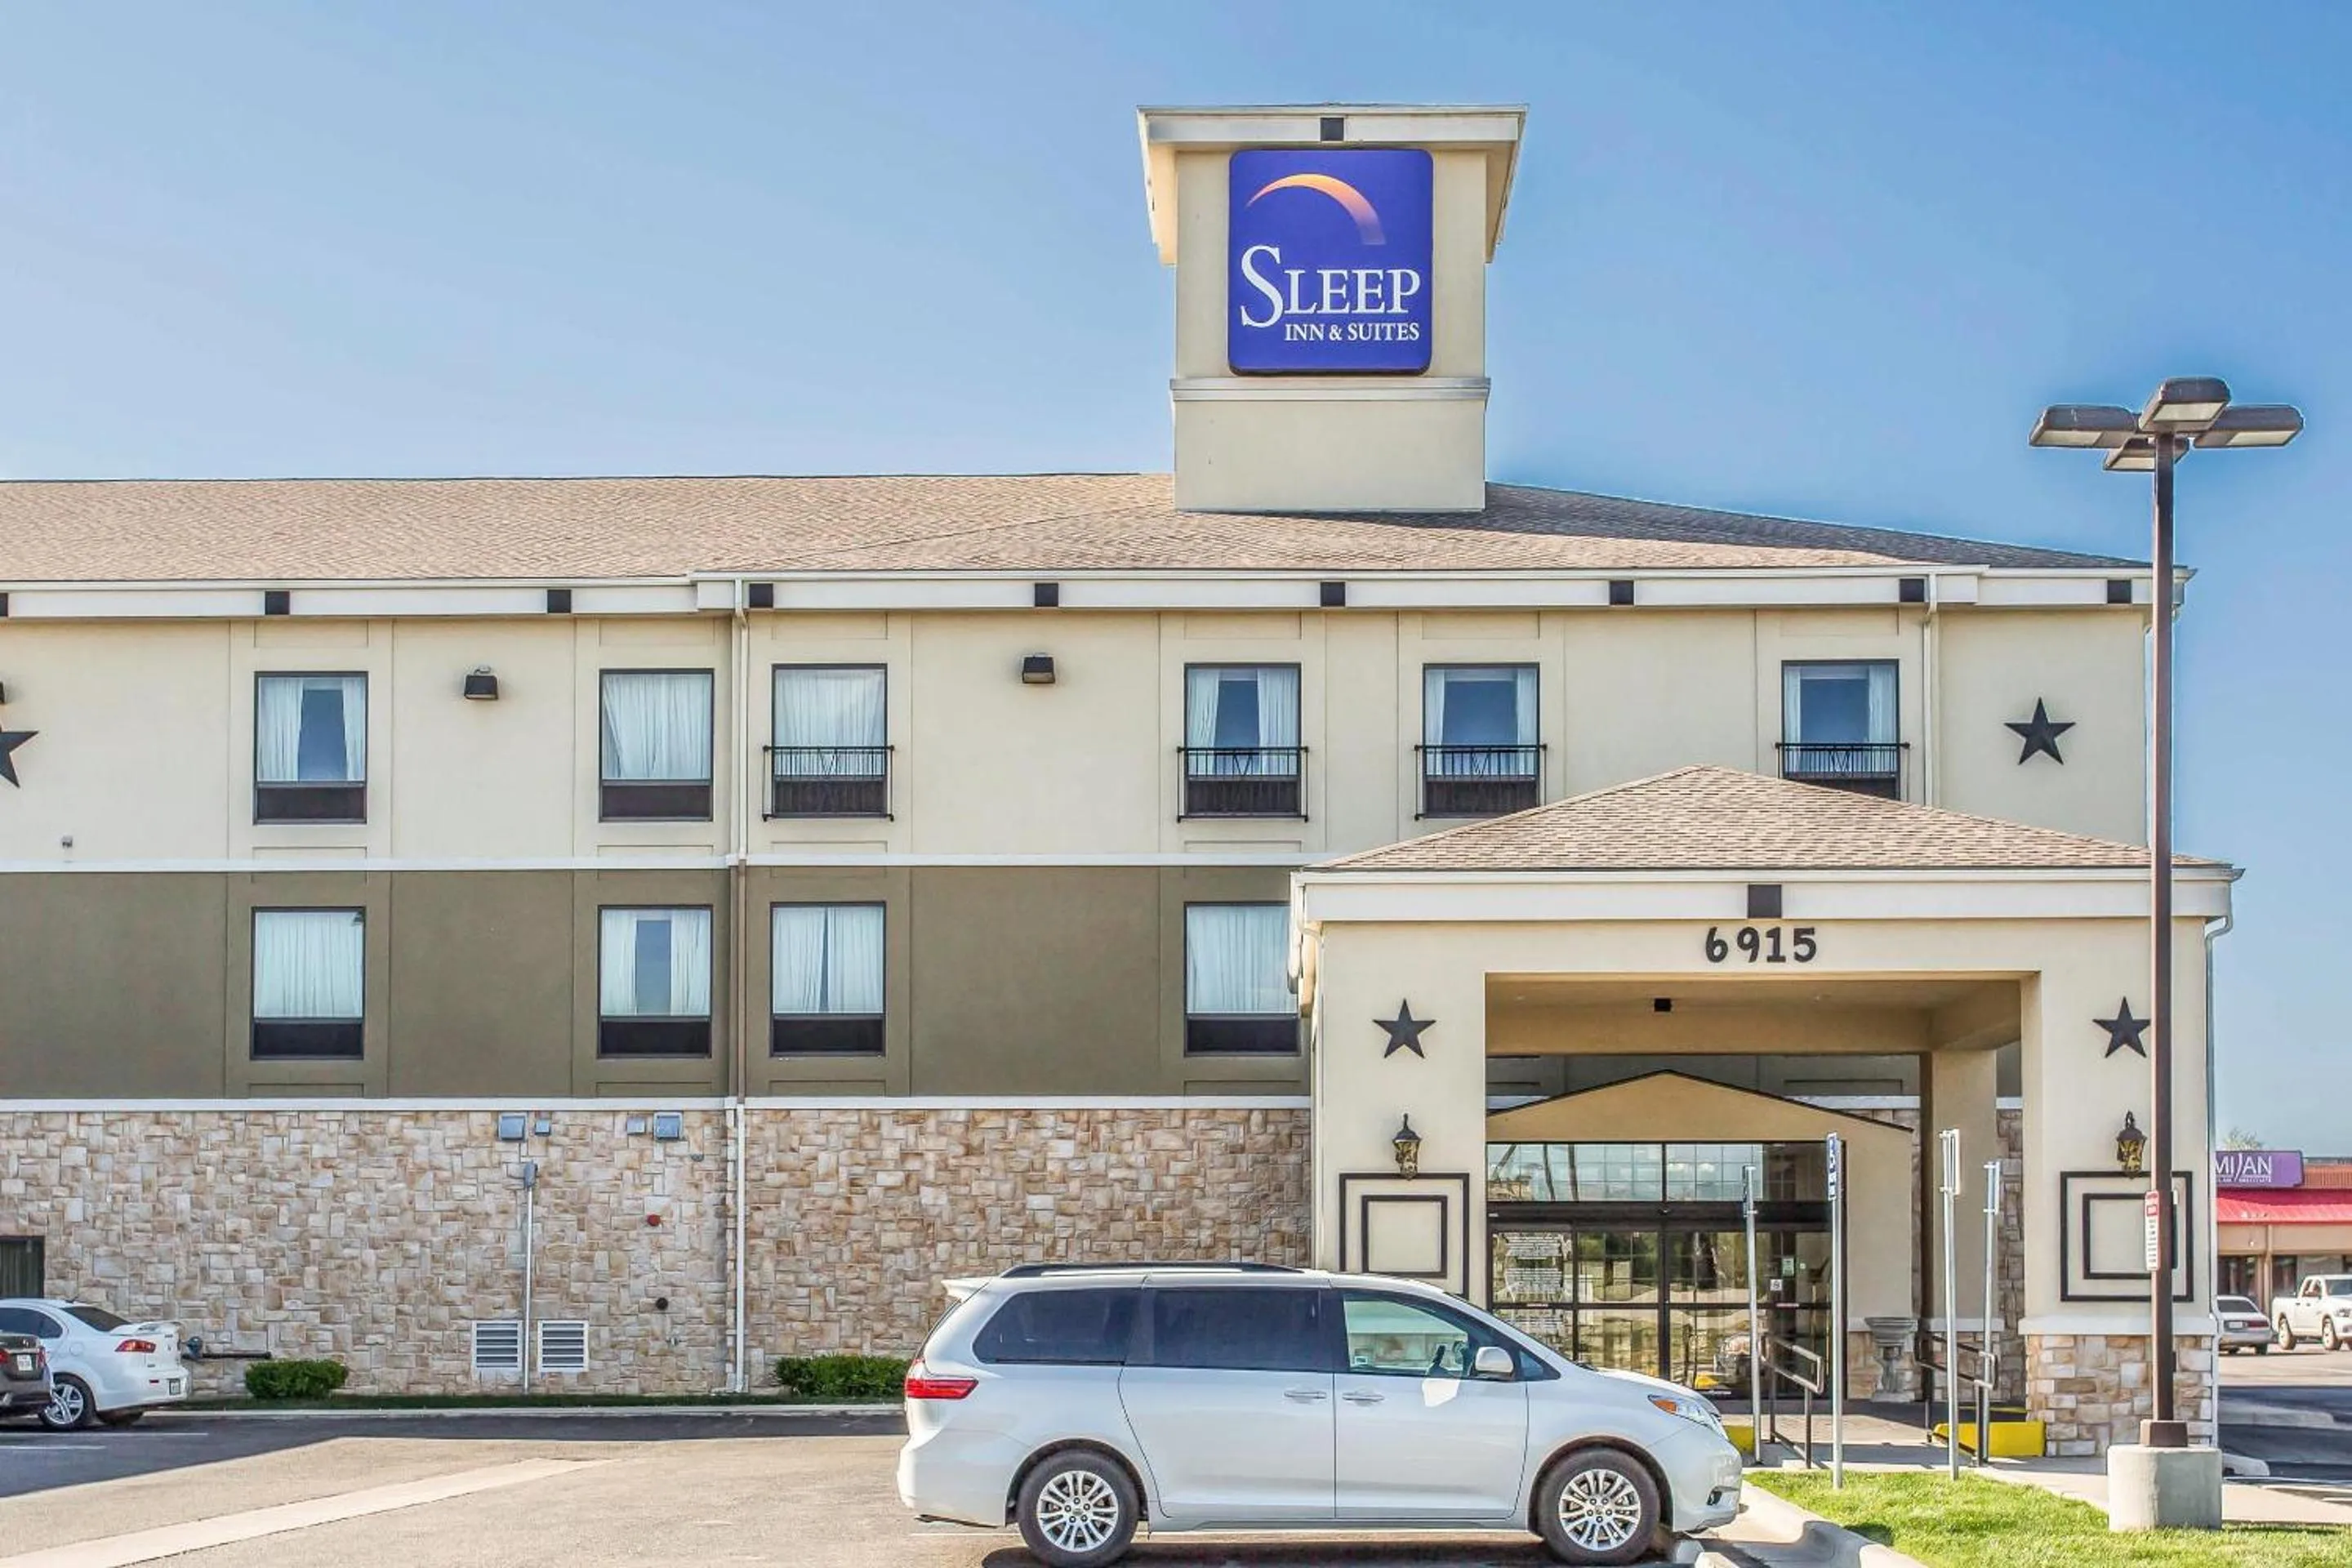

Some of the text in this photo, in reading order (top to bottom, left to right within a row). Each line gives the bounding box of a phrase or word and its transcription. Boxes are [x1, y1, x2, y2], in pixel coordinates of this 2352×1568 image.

[1241, 244, 1421, 328] SLEEP
[1285, 322, 1420, 341] INN & SUITES
[1705, 926, 1817, 963] 6915
